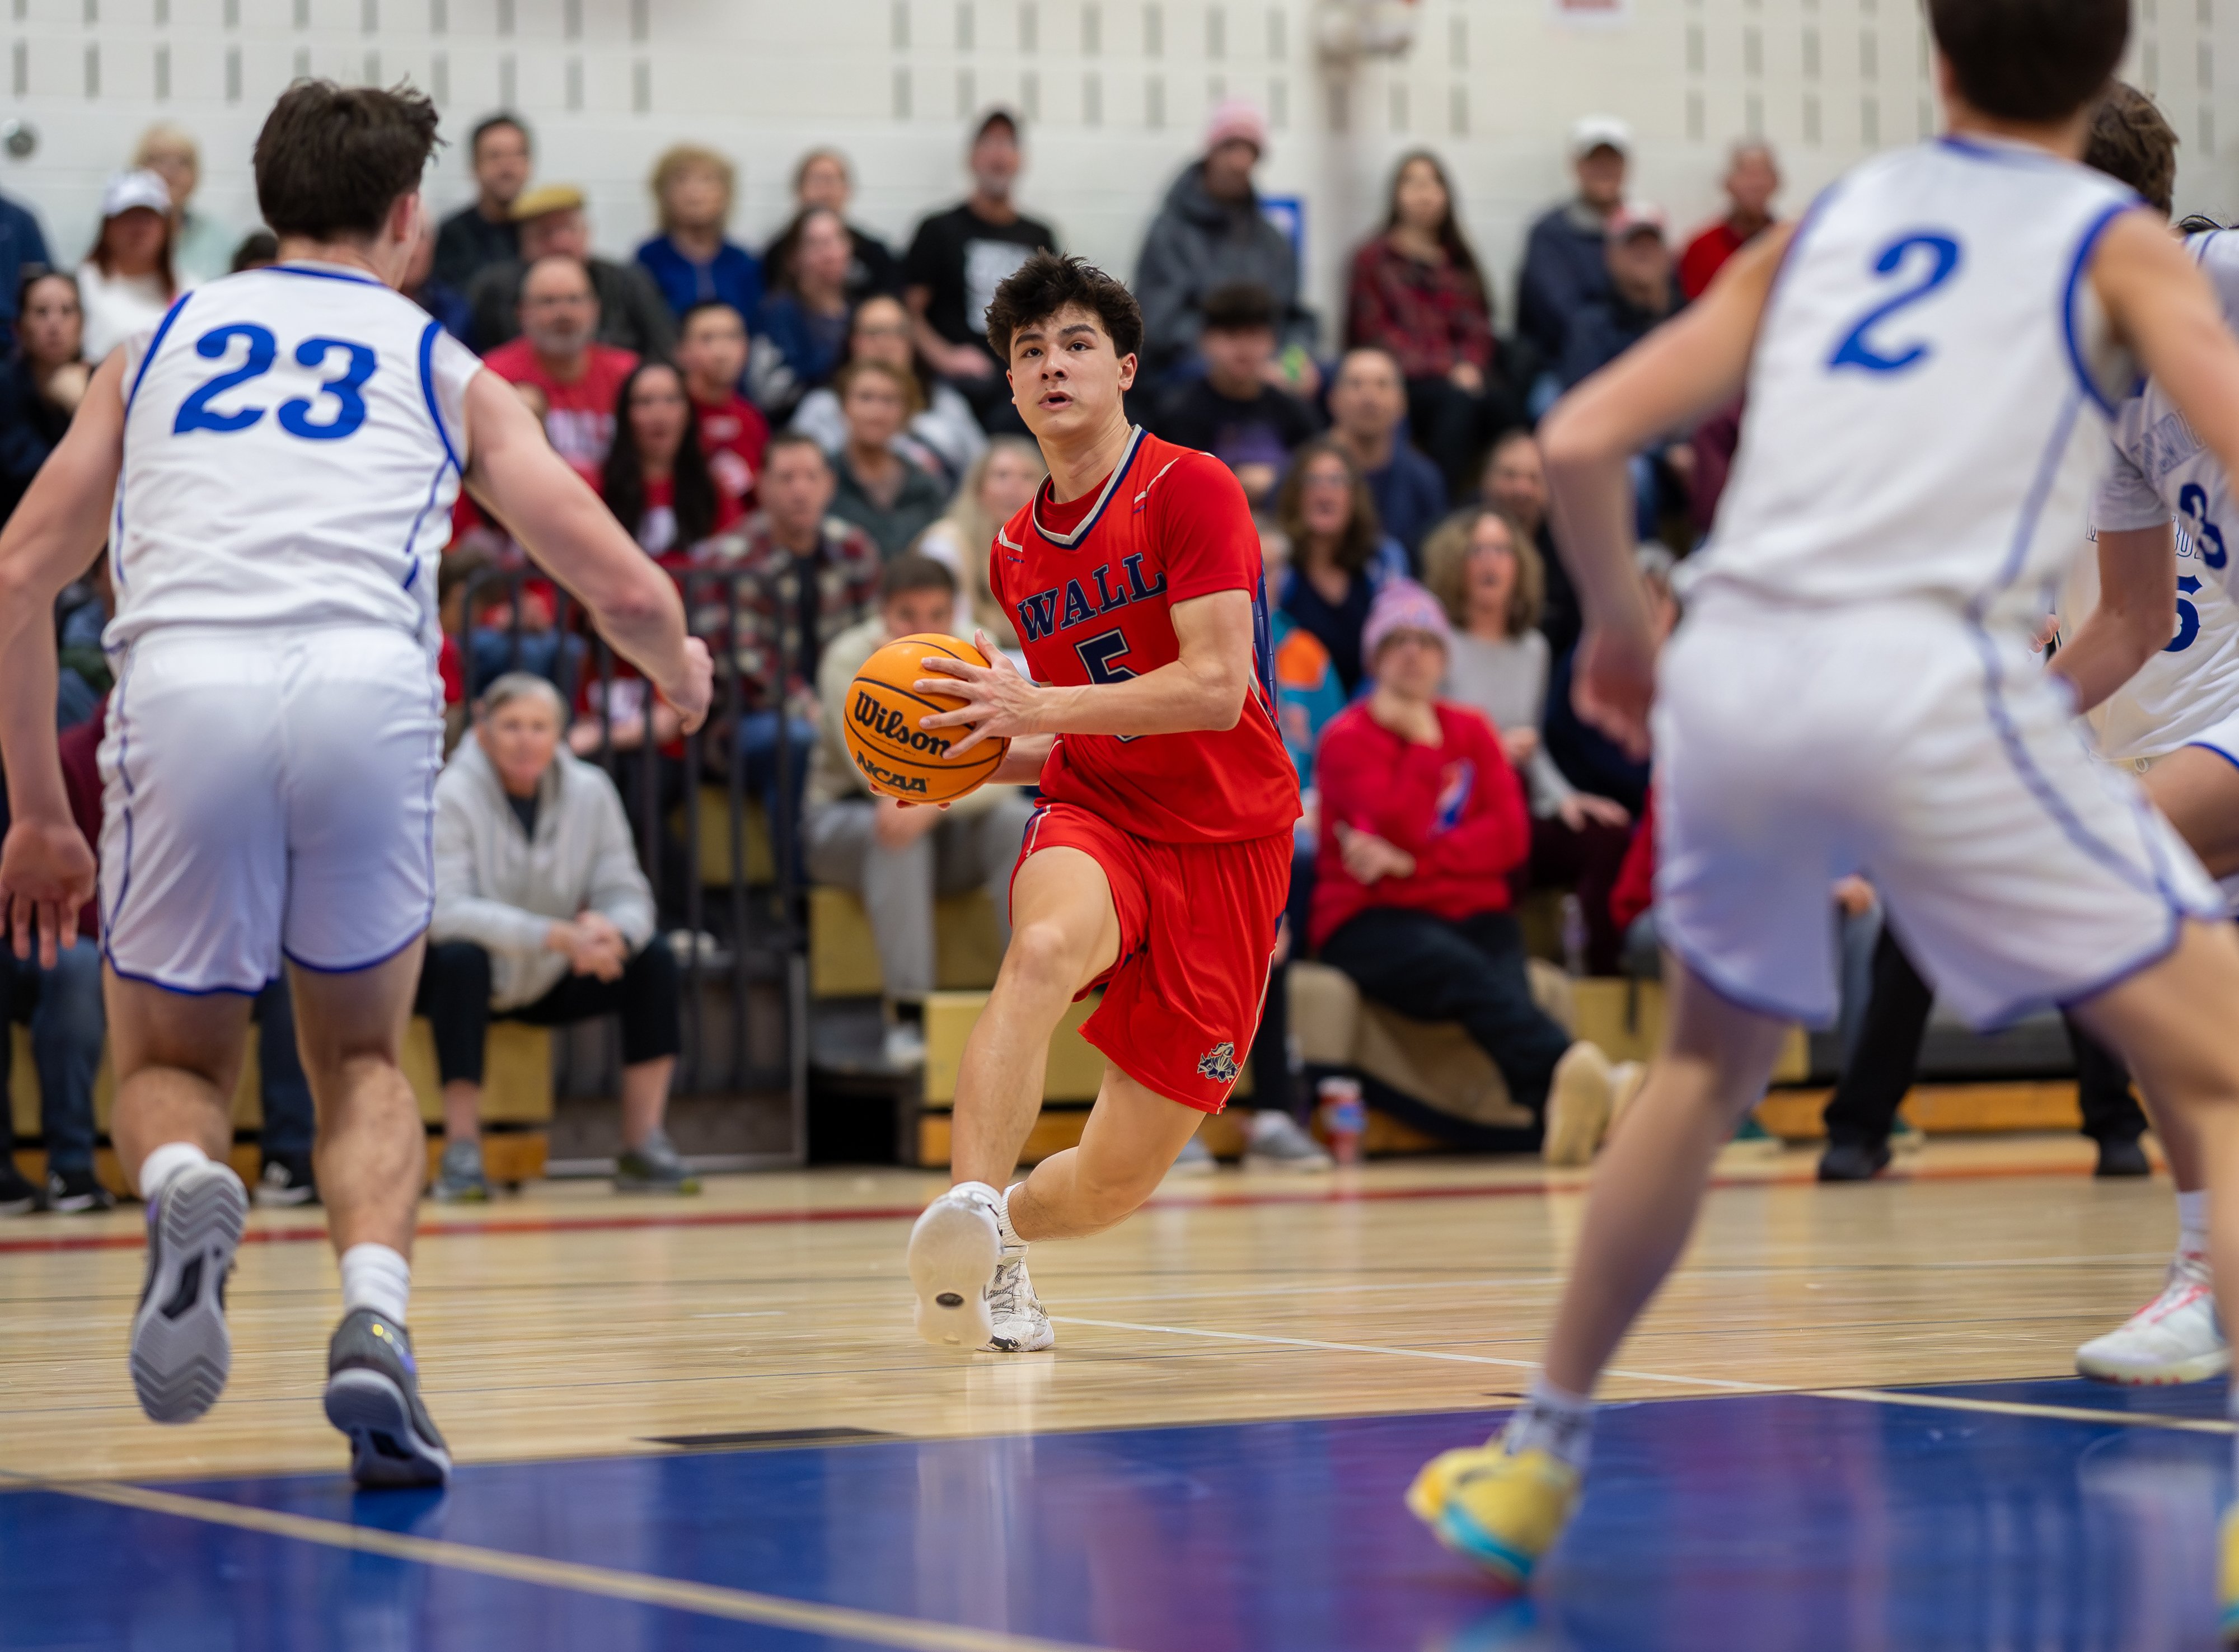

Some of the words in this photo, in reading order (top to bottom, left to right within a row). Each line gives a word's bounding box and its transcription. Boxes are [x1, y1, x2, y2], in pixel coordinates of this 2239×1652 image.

[1828, 233, 1961, 373] 2
[172, 321, 380, 441] 23
[1017, 552, 1168, 643] WALL
[854, 691, 951, 757] Wilson
[856, 750, 928, 793] NCAA
